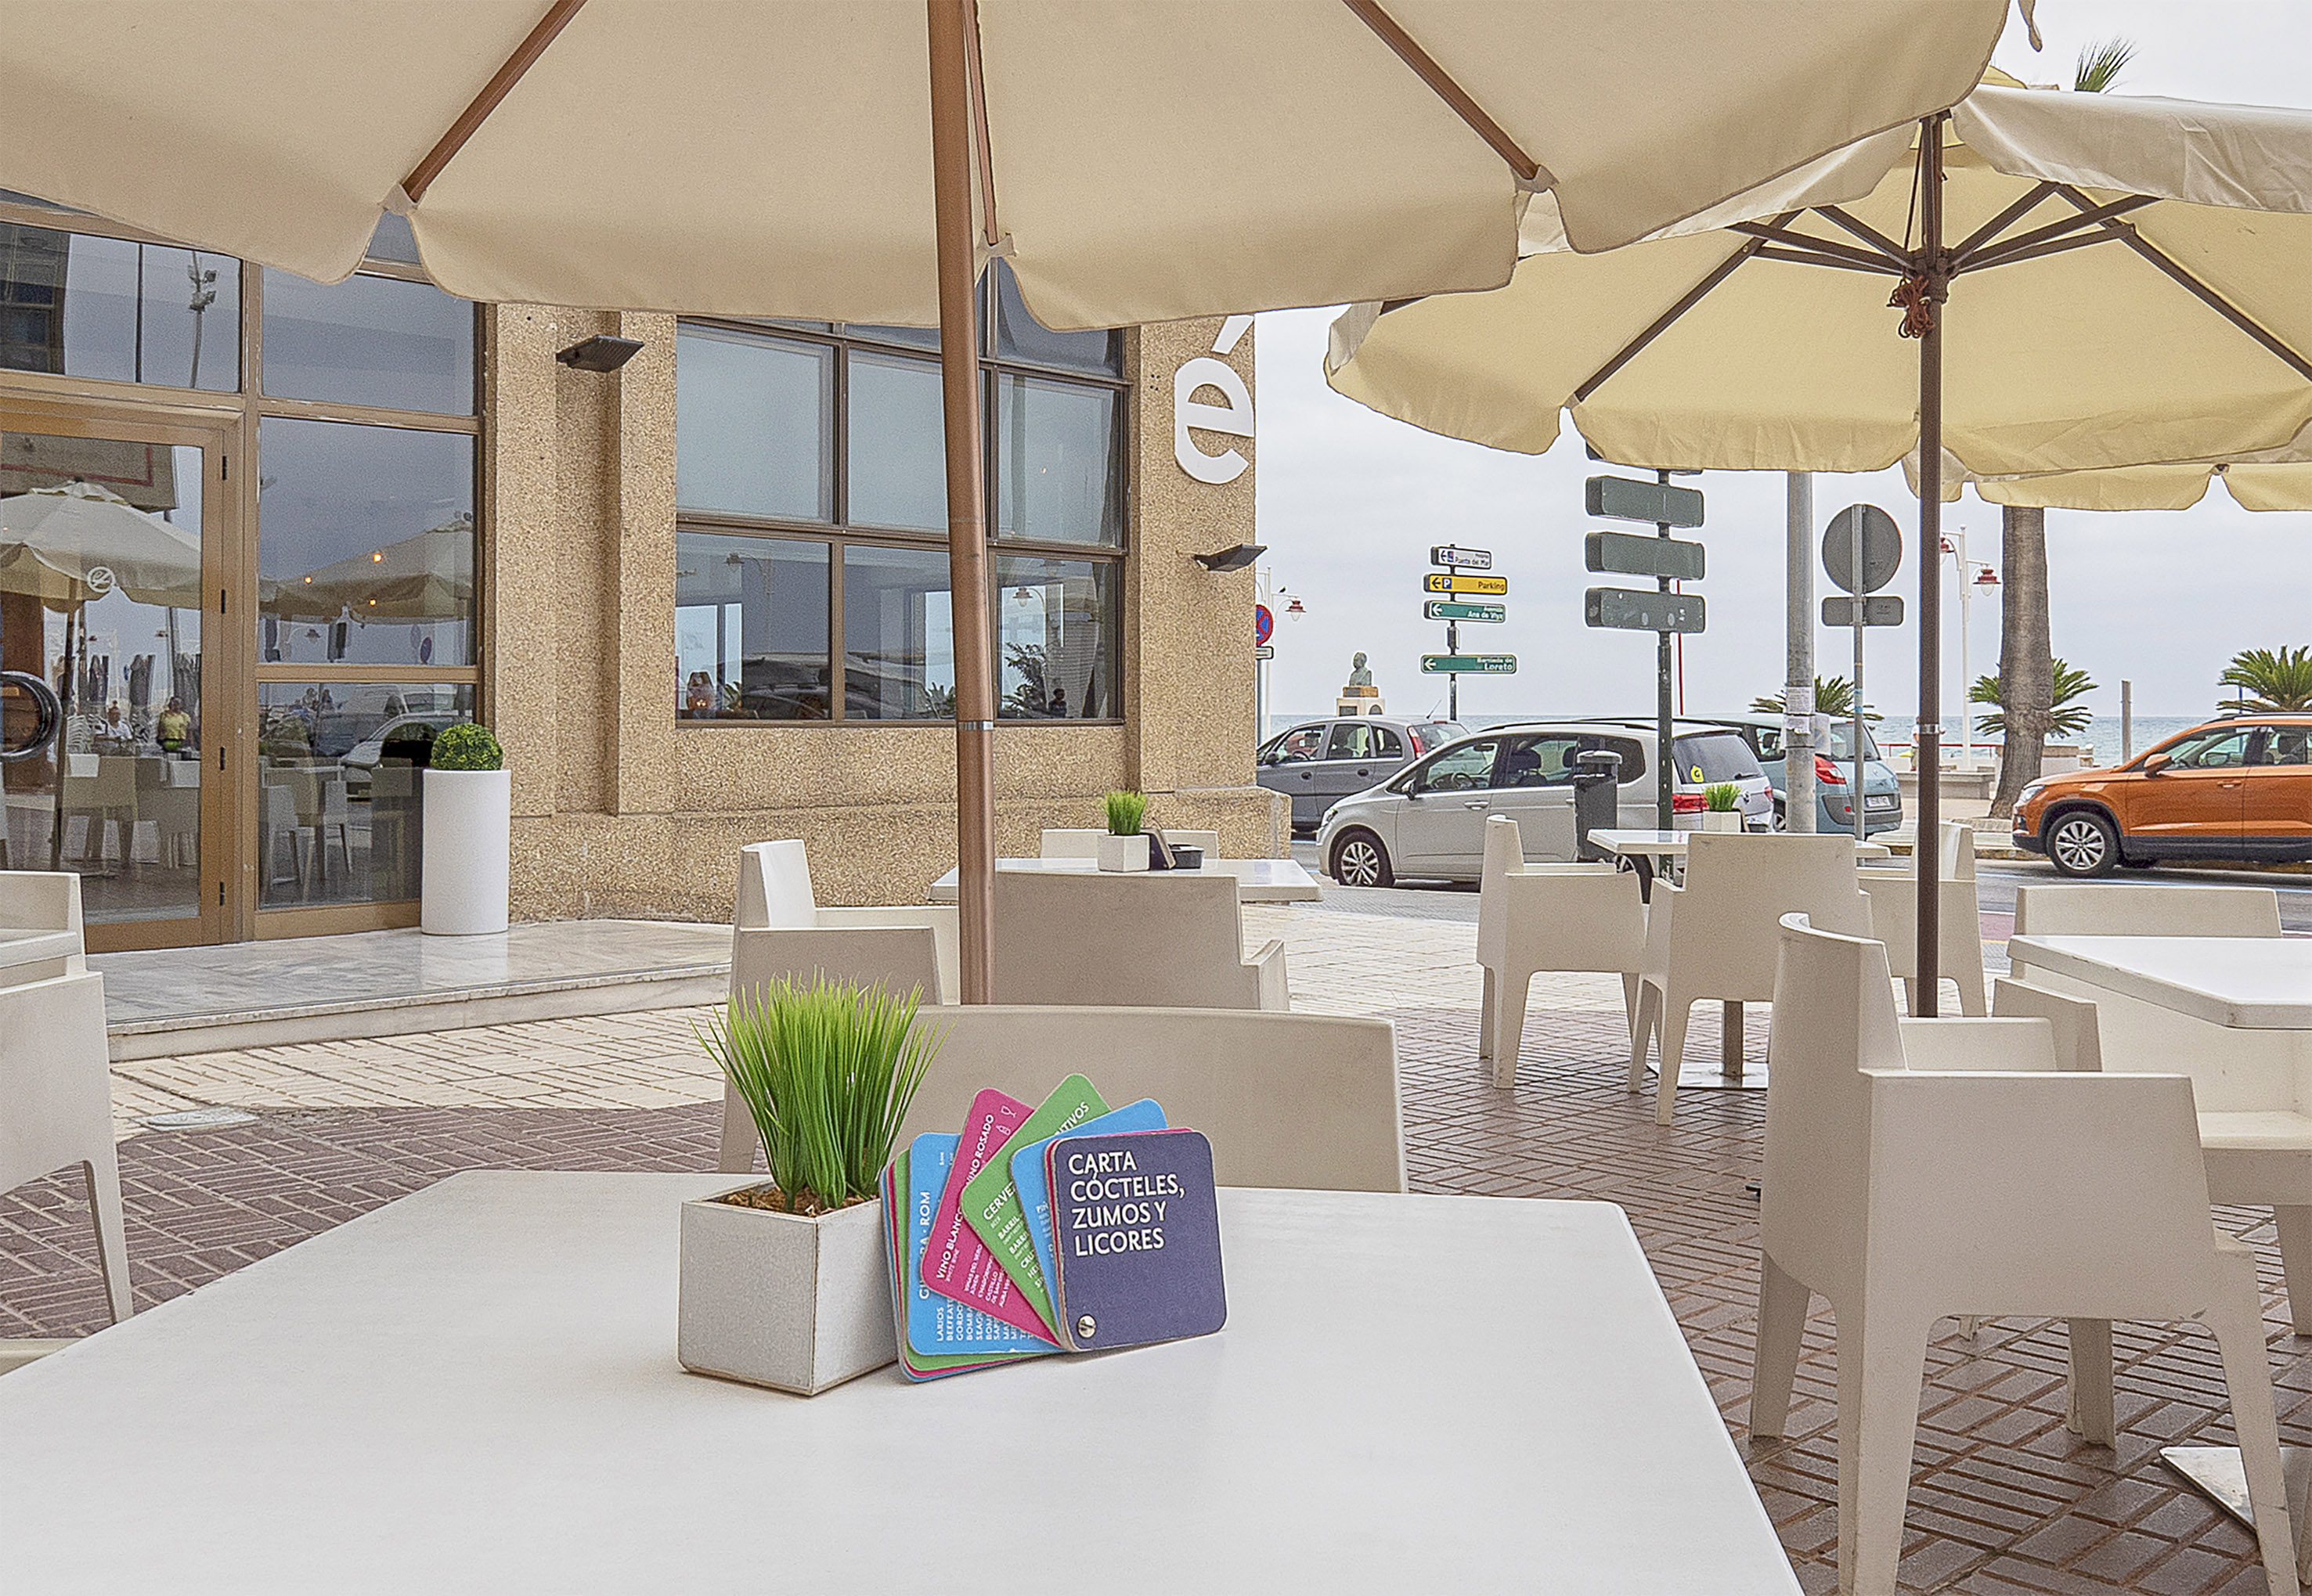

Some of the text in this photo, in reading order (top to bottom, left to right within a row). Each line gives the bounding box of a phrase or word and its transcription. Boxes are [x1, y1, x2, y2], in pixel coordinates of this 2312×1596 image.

[1443, 578, 1505, 592] P Parking
[1484, 662, 1513, 671] Loreto
[1068, 1151, 1138, 1175] CARTA
[936, 1251, 952, 1279] VINO
[974, 1114, 994, 1158] ROSADO
[1070, 1172, 1185, 1202] CÓCTELES,
[919, 1191, 931, 1226] ROM
[1071, 1202, 1151, 1229] ZUMOS
[1153, 1200, 1167, 1222] Y
[1074, 1227, 1165, 1257] LICORES
